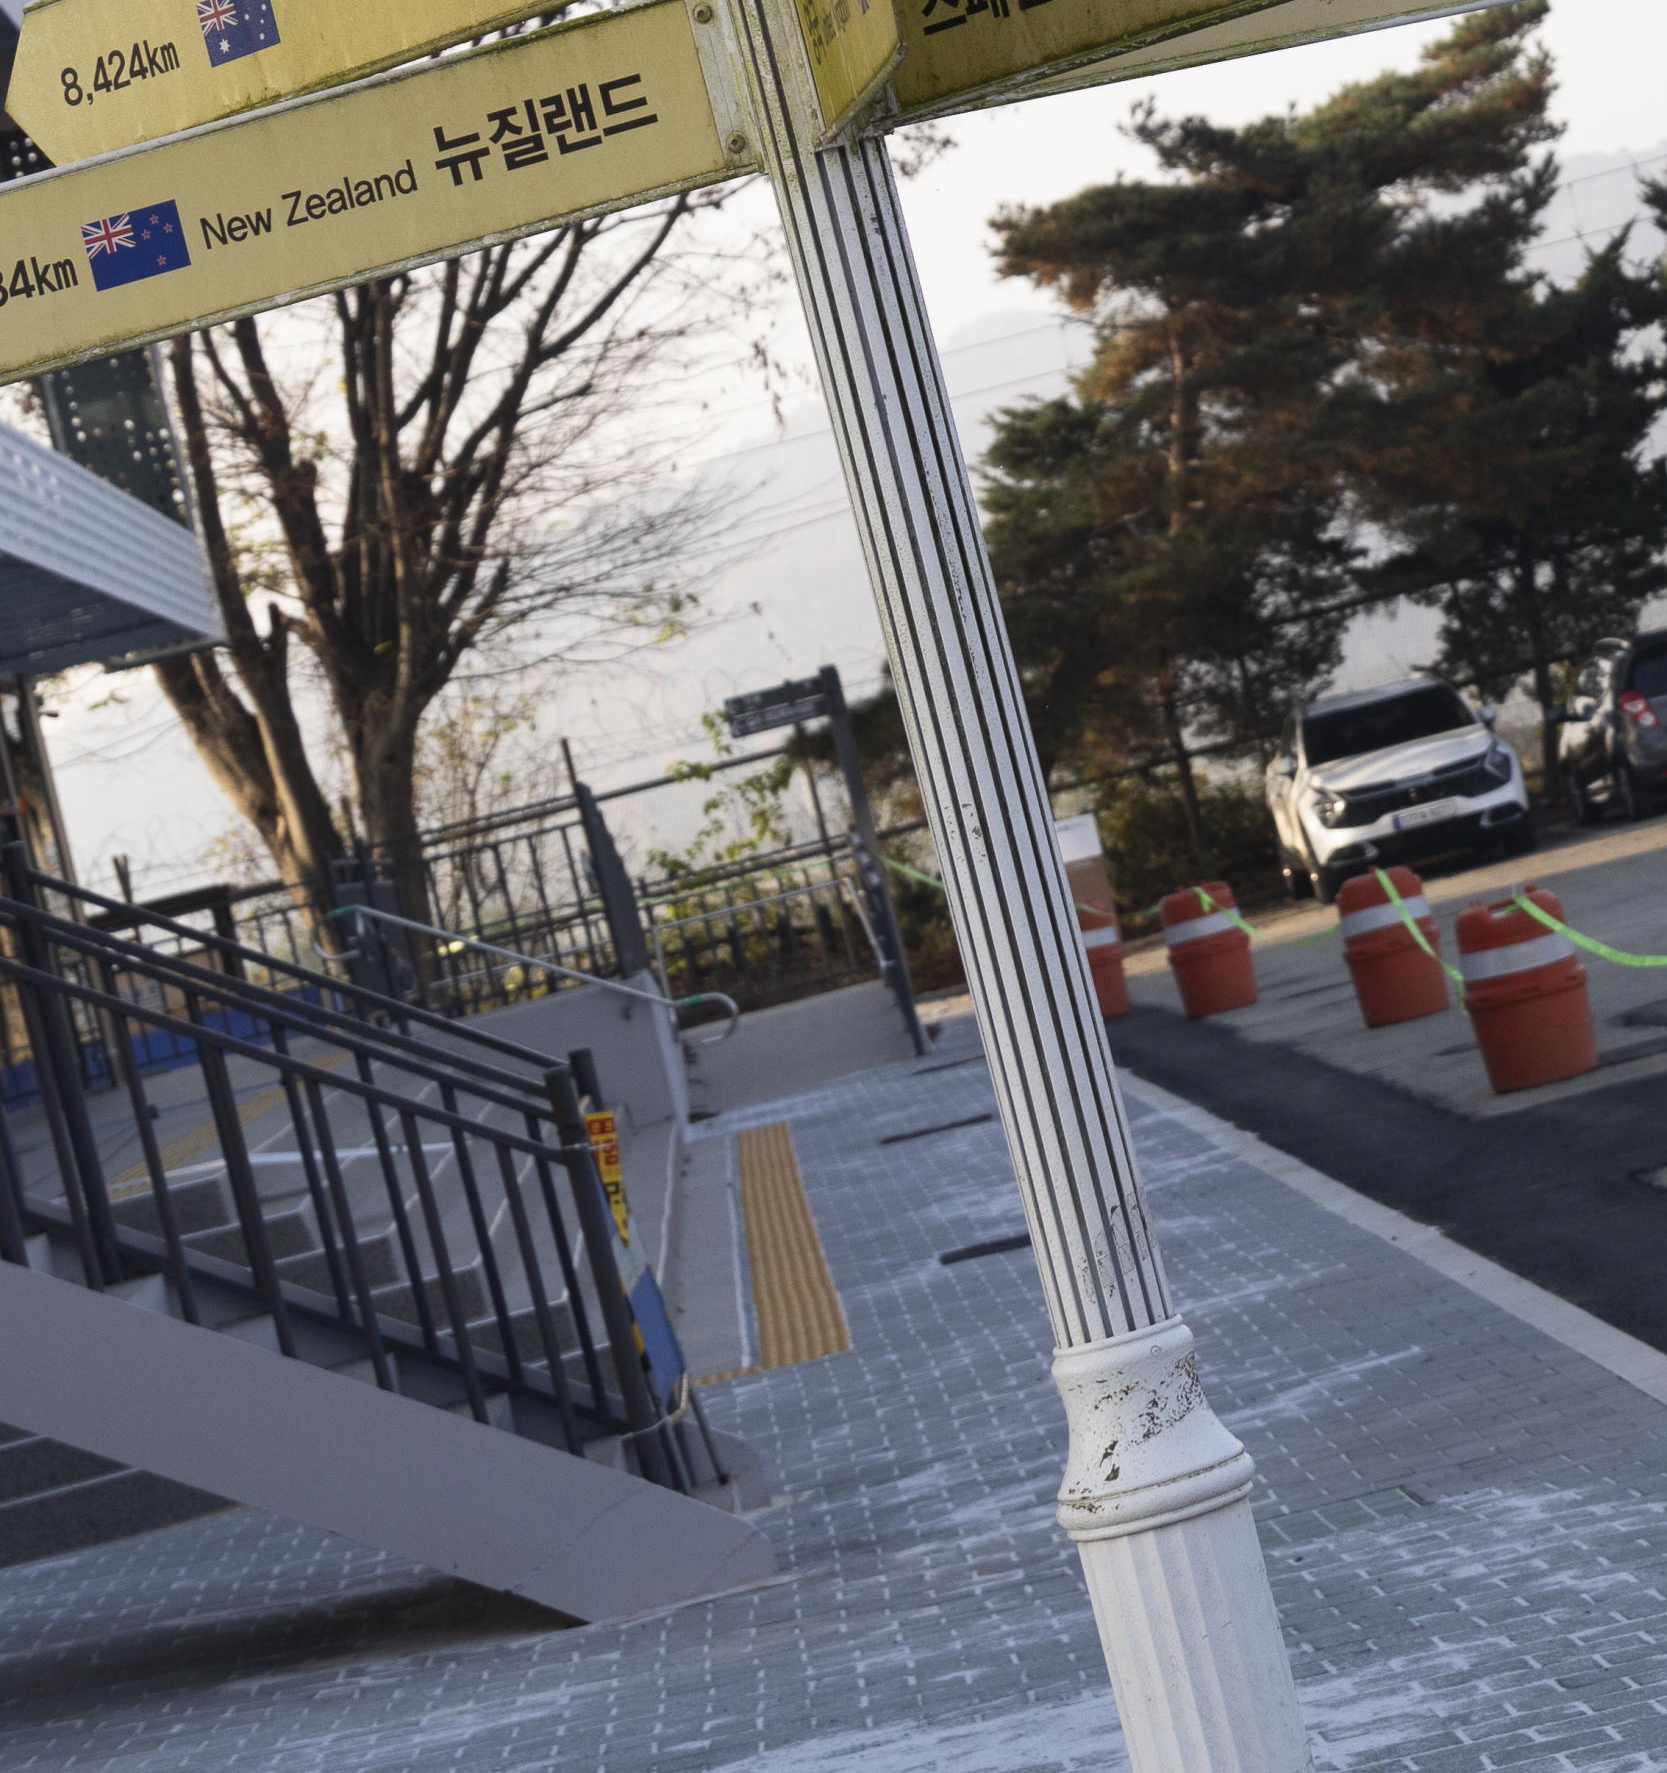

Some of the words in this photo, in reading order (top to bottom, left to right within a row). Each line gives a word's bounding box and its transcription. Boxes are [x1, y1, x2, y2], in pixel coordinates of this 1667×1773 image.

[60, 38, 182, 108] 8,424km
[199, 211, 273, 251] New
[282, 159, 418, 226] Zealand
[433, 72, 659, 187] 뉴질랜드
